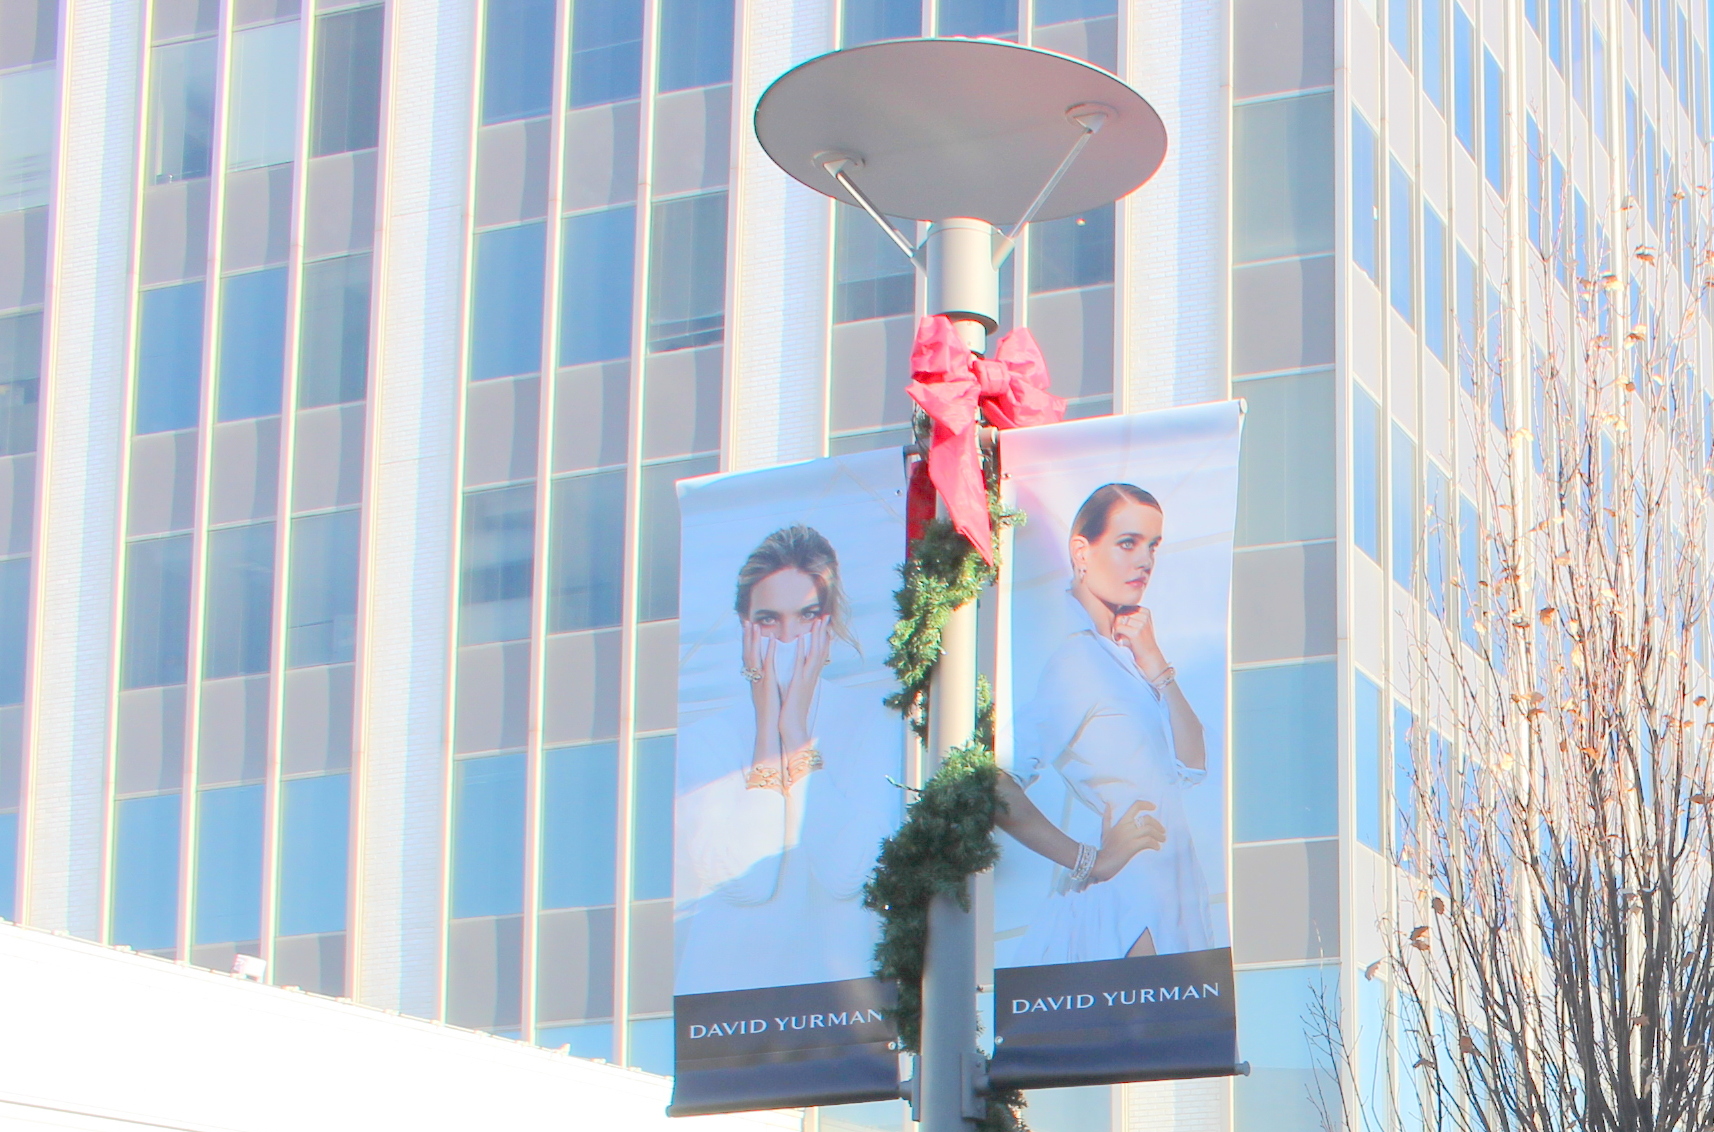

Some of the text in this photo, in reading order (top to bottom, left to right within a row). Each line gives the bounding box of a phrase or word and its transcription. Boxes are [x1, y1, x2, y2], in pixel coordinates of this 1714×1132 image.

[1012, 982, 1219, 1014] DAVID YURMAN
[689, 1008, 884, 1039] DAVID YURMAN
